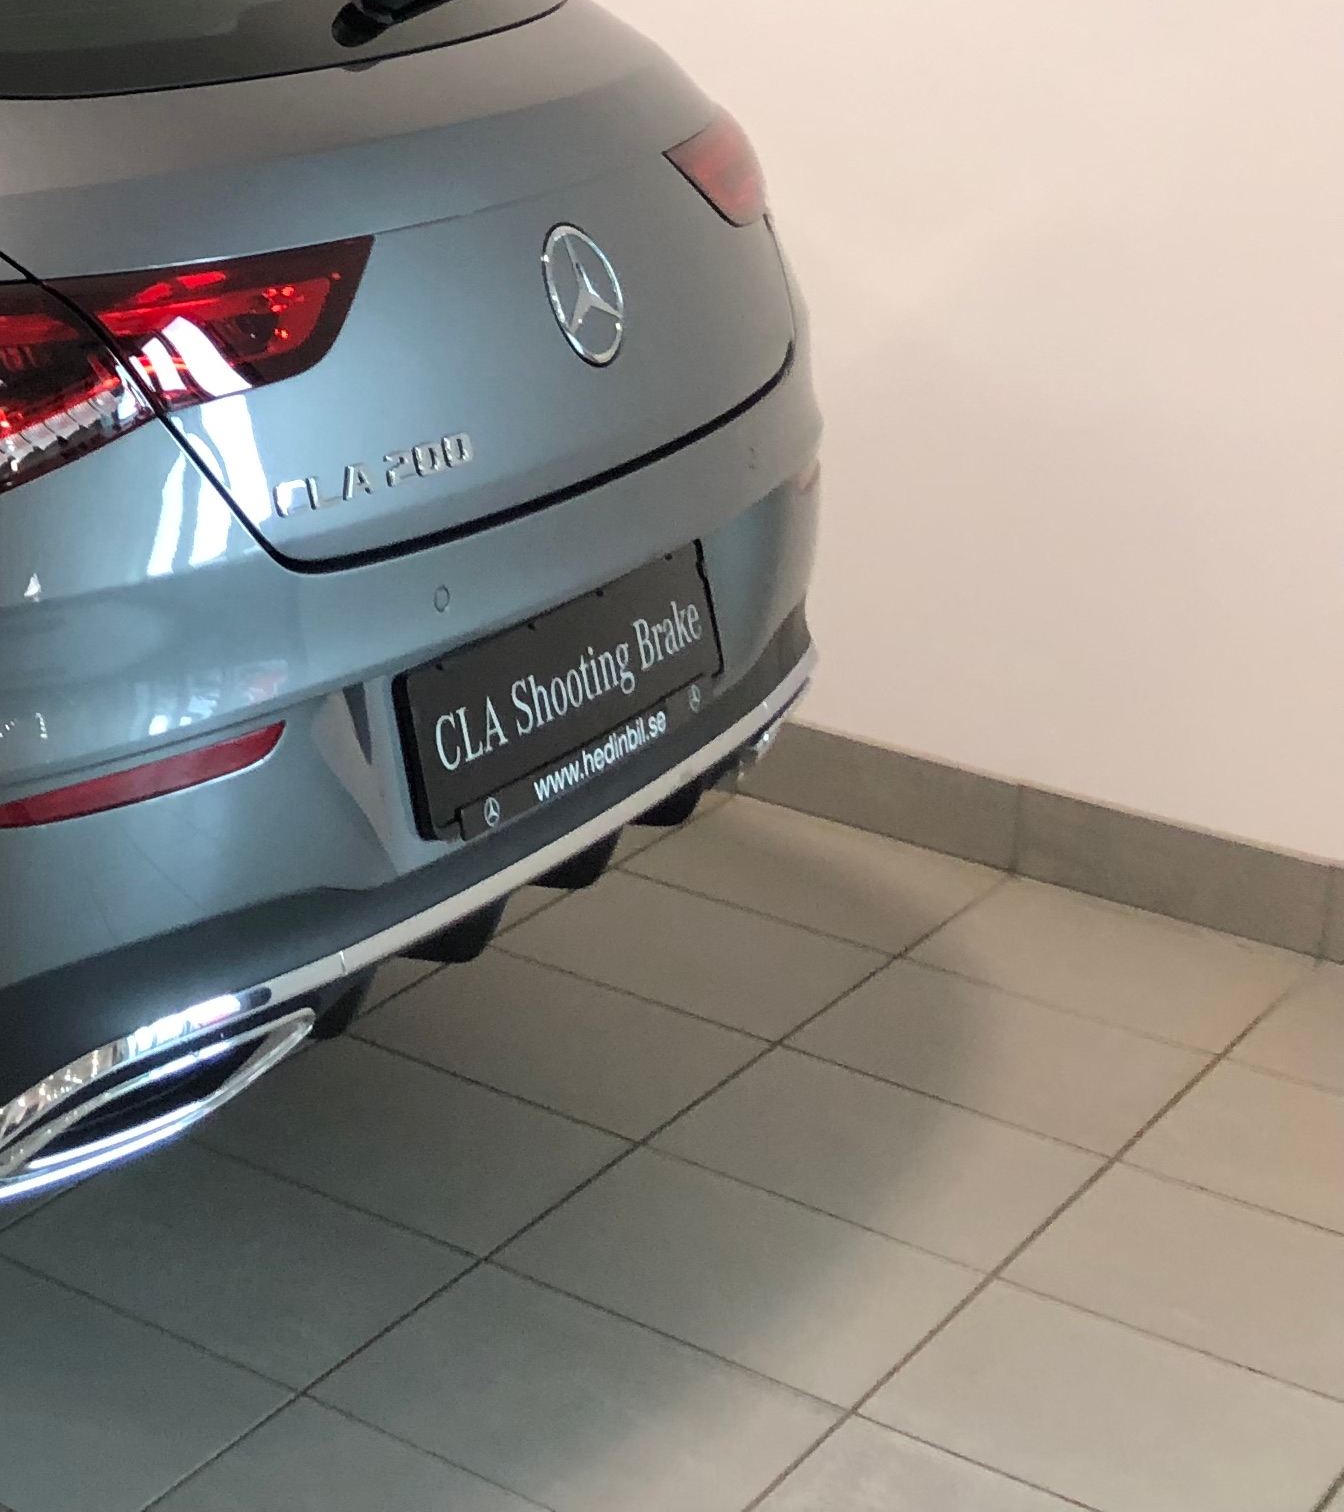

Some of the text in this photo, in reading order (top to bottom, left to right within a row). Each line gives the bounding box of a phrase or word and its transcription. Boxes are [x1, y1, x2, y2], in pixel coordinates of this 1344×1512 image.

[273, 433, 475, 518] CLA 200
[435, 601, 703, 771] CLA Shooting Brake
[533, 710, 667, 802] www.hedinbil.se
